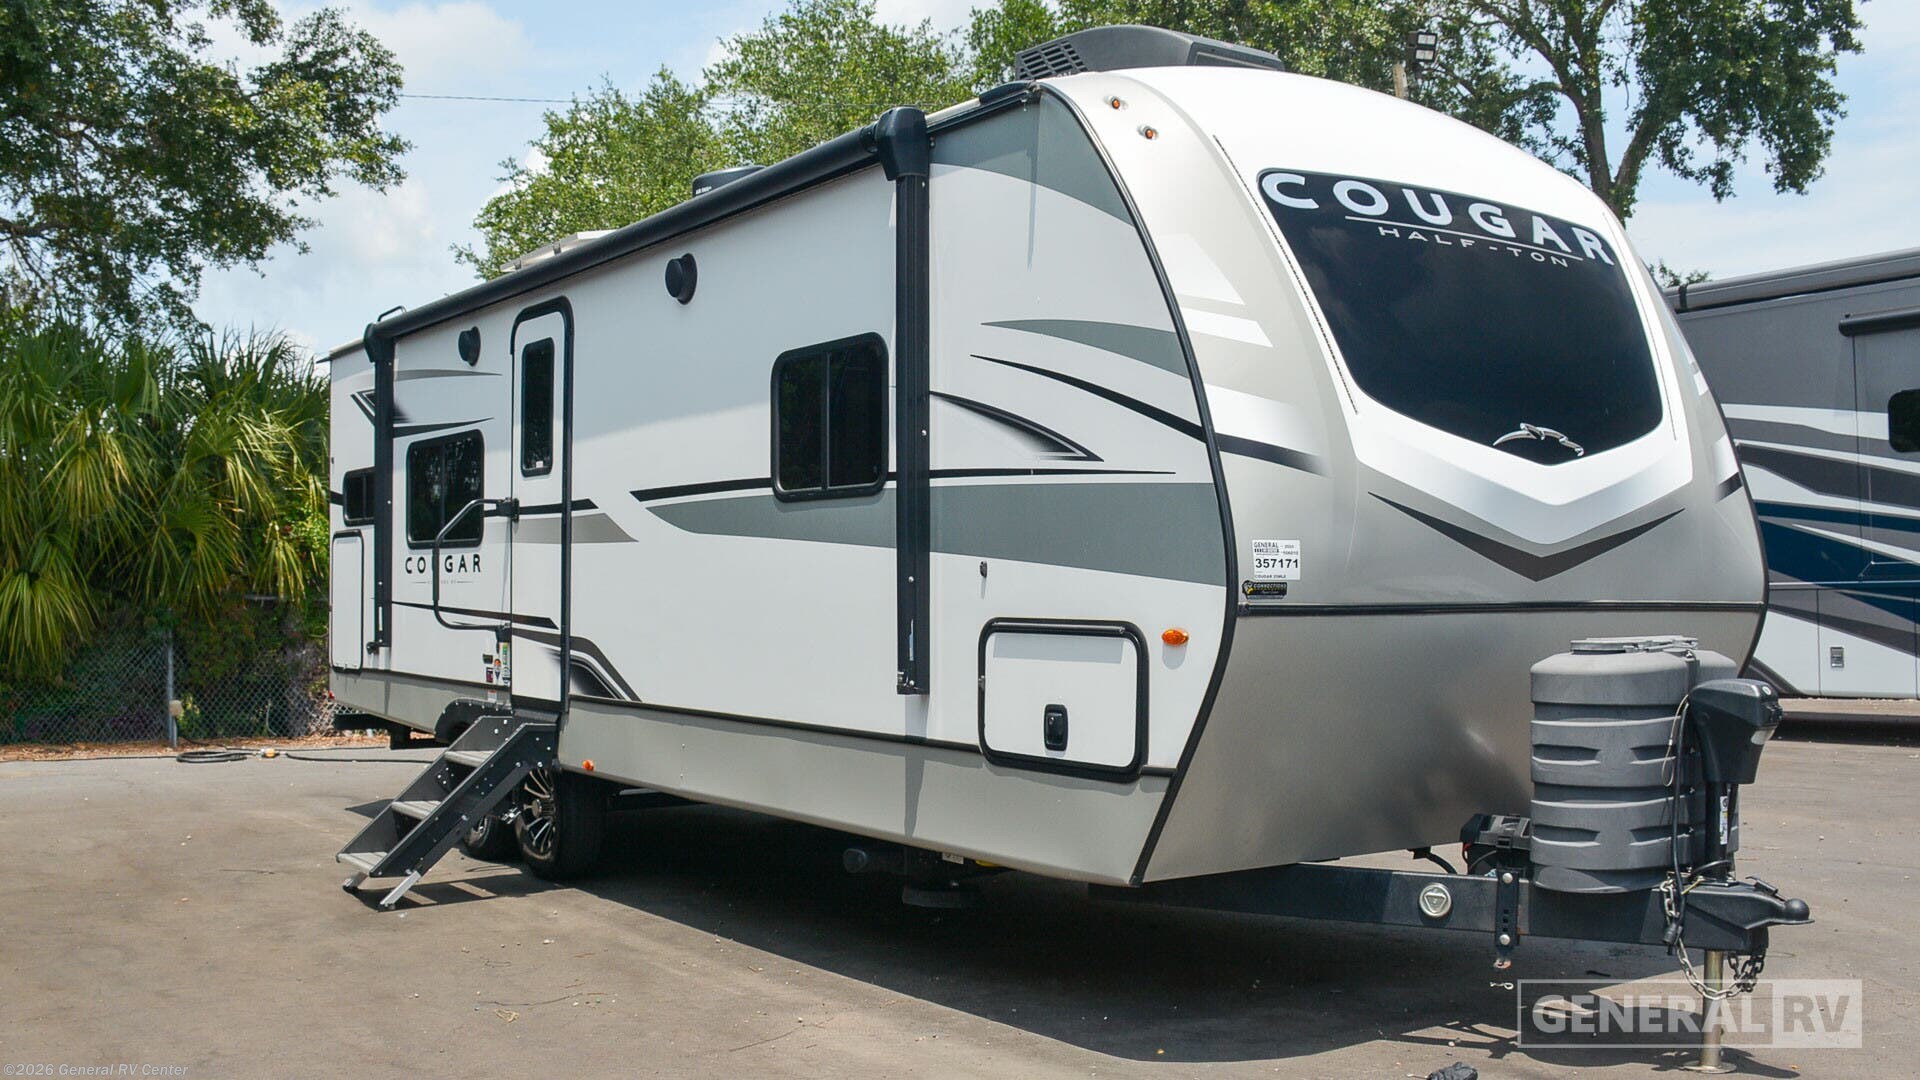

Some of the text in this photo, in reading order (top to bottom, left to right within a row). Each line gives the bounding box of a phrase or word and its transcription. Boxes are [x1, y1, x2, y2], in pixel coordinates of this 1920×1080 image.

[1262, 173, 1615, 266] COUGAR
[405, 553, 481, 574] COGAR
[1255, 558, 1298, 568] 357171
